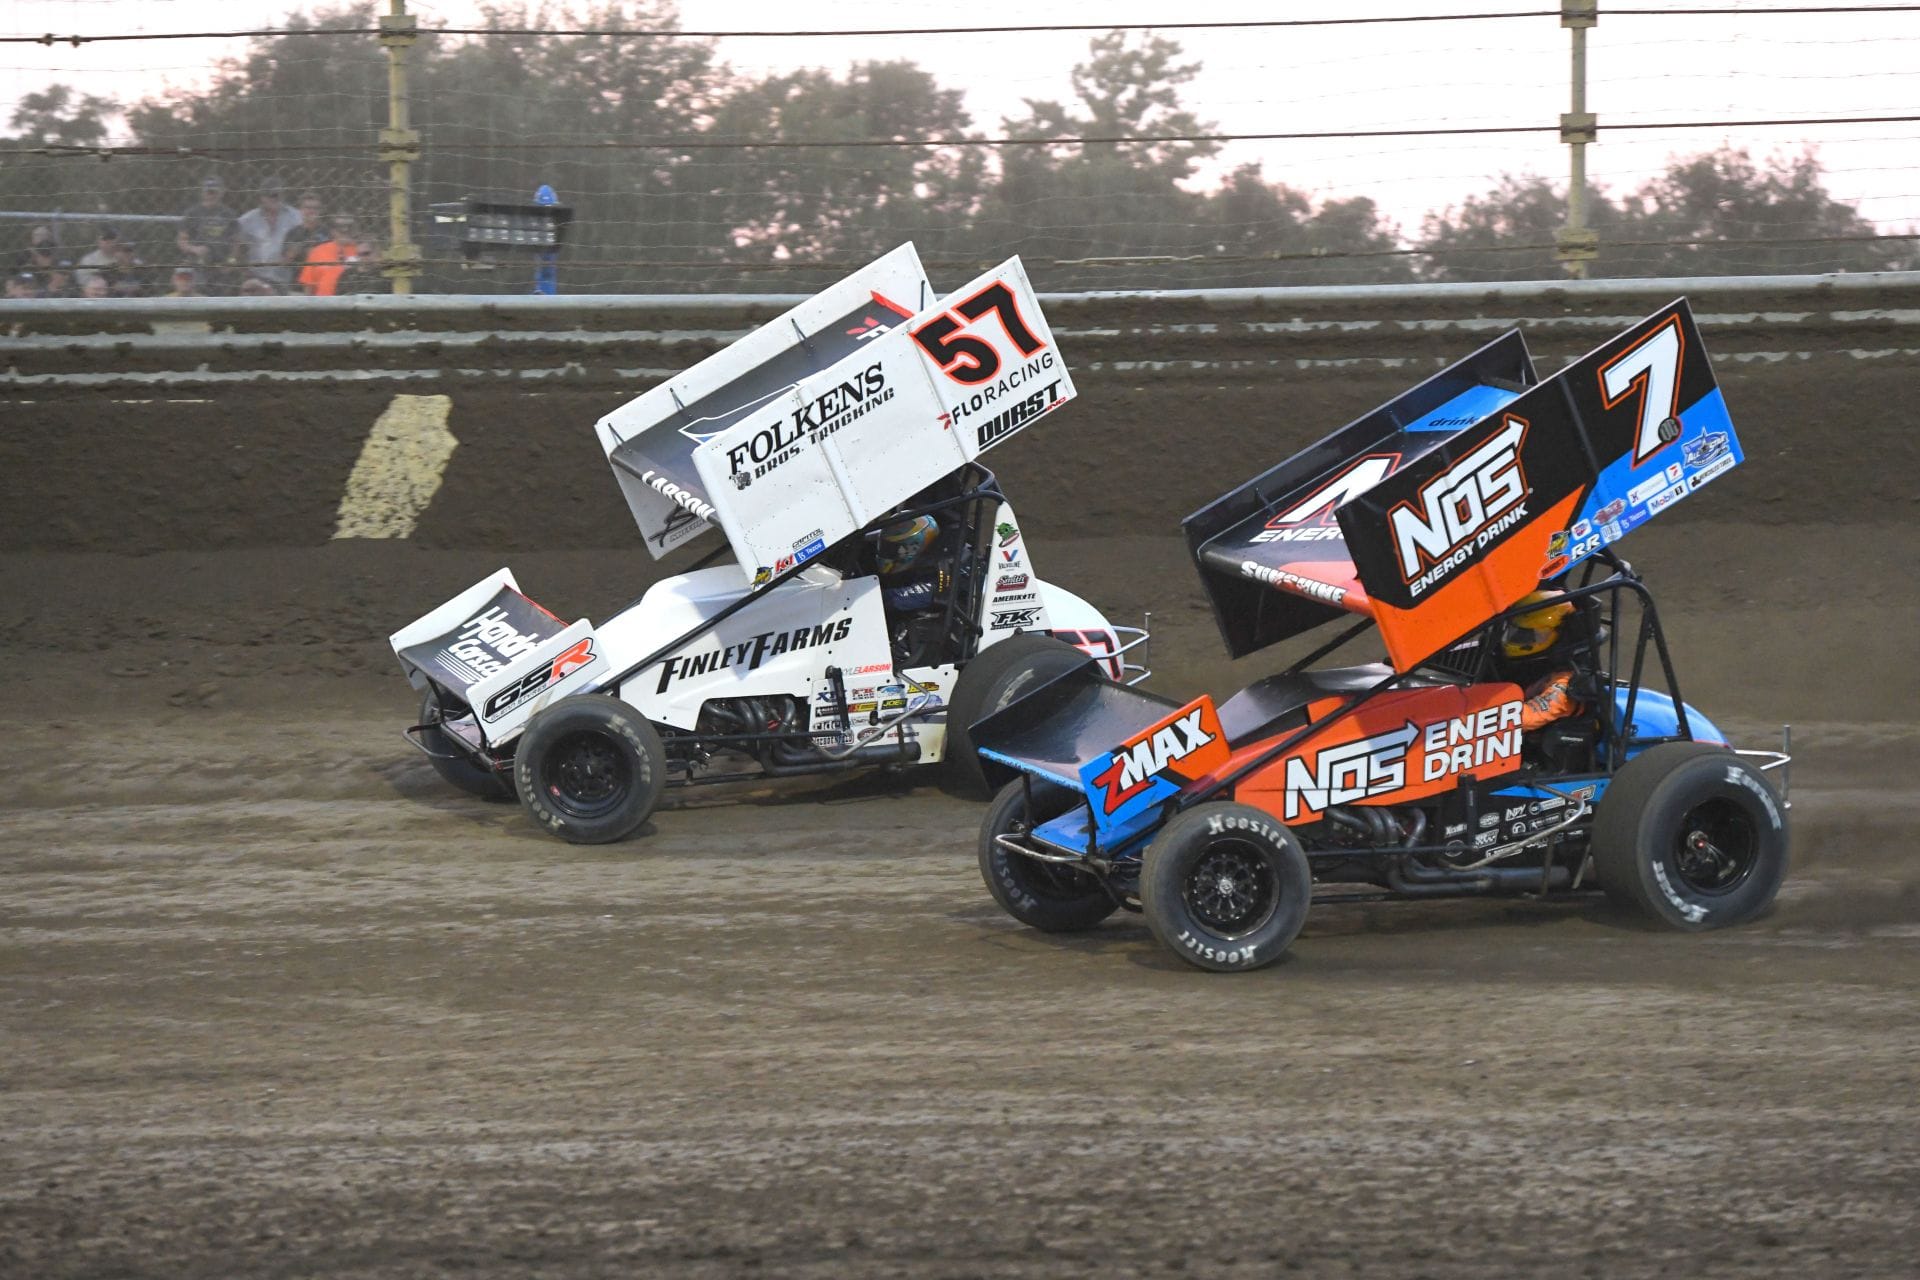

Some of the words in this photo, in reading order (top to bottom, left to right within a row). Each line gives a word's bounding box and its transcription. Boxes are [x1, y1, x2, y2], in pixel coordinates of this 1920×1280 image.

[908, 280, 1047, 386] 57
[726, 361, 886, 477] FOLKENS
[754, 443, 805, 480] BROS.
[808, 387, 895, 446] TRUCKING
[977, 379, 1062, 447] DURST
[1597, 312, 1685, 471] 7
[1391, 419, 1525, 580] NOS
[1650, 491, 1676, 510] Mobil
[1241, 561, 1347, 604] SUNSHINE
[1410, 544, 1476, 598] ENERGY
[1477, 502, 1529, 549] DRINK
[655, 641, 752, 695] FINLEY
[749, 617, 852, 671] FARMS
[857, 663, 892, 674] LARSON
[1285, 721, 1421, 821] NOS
